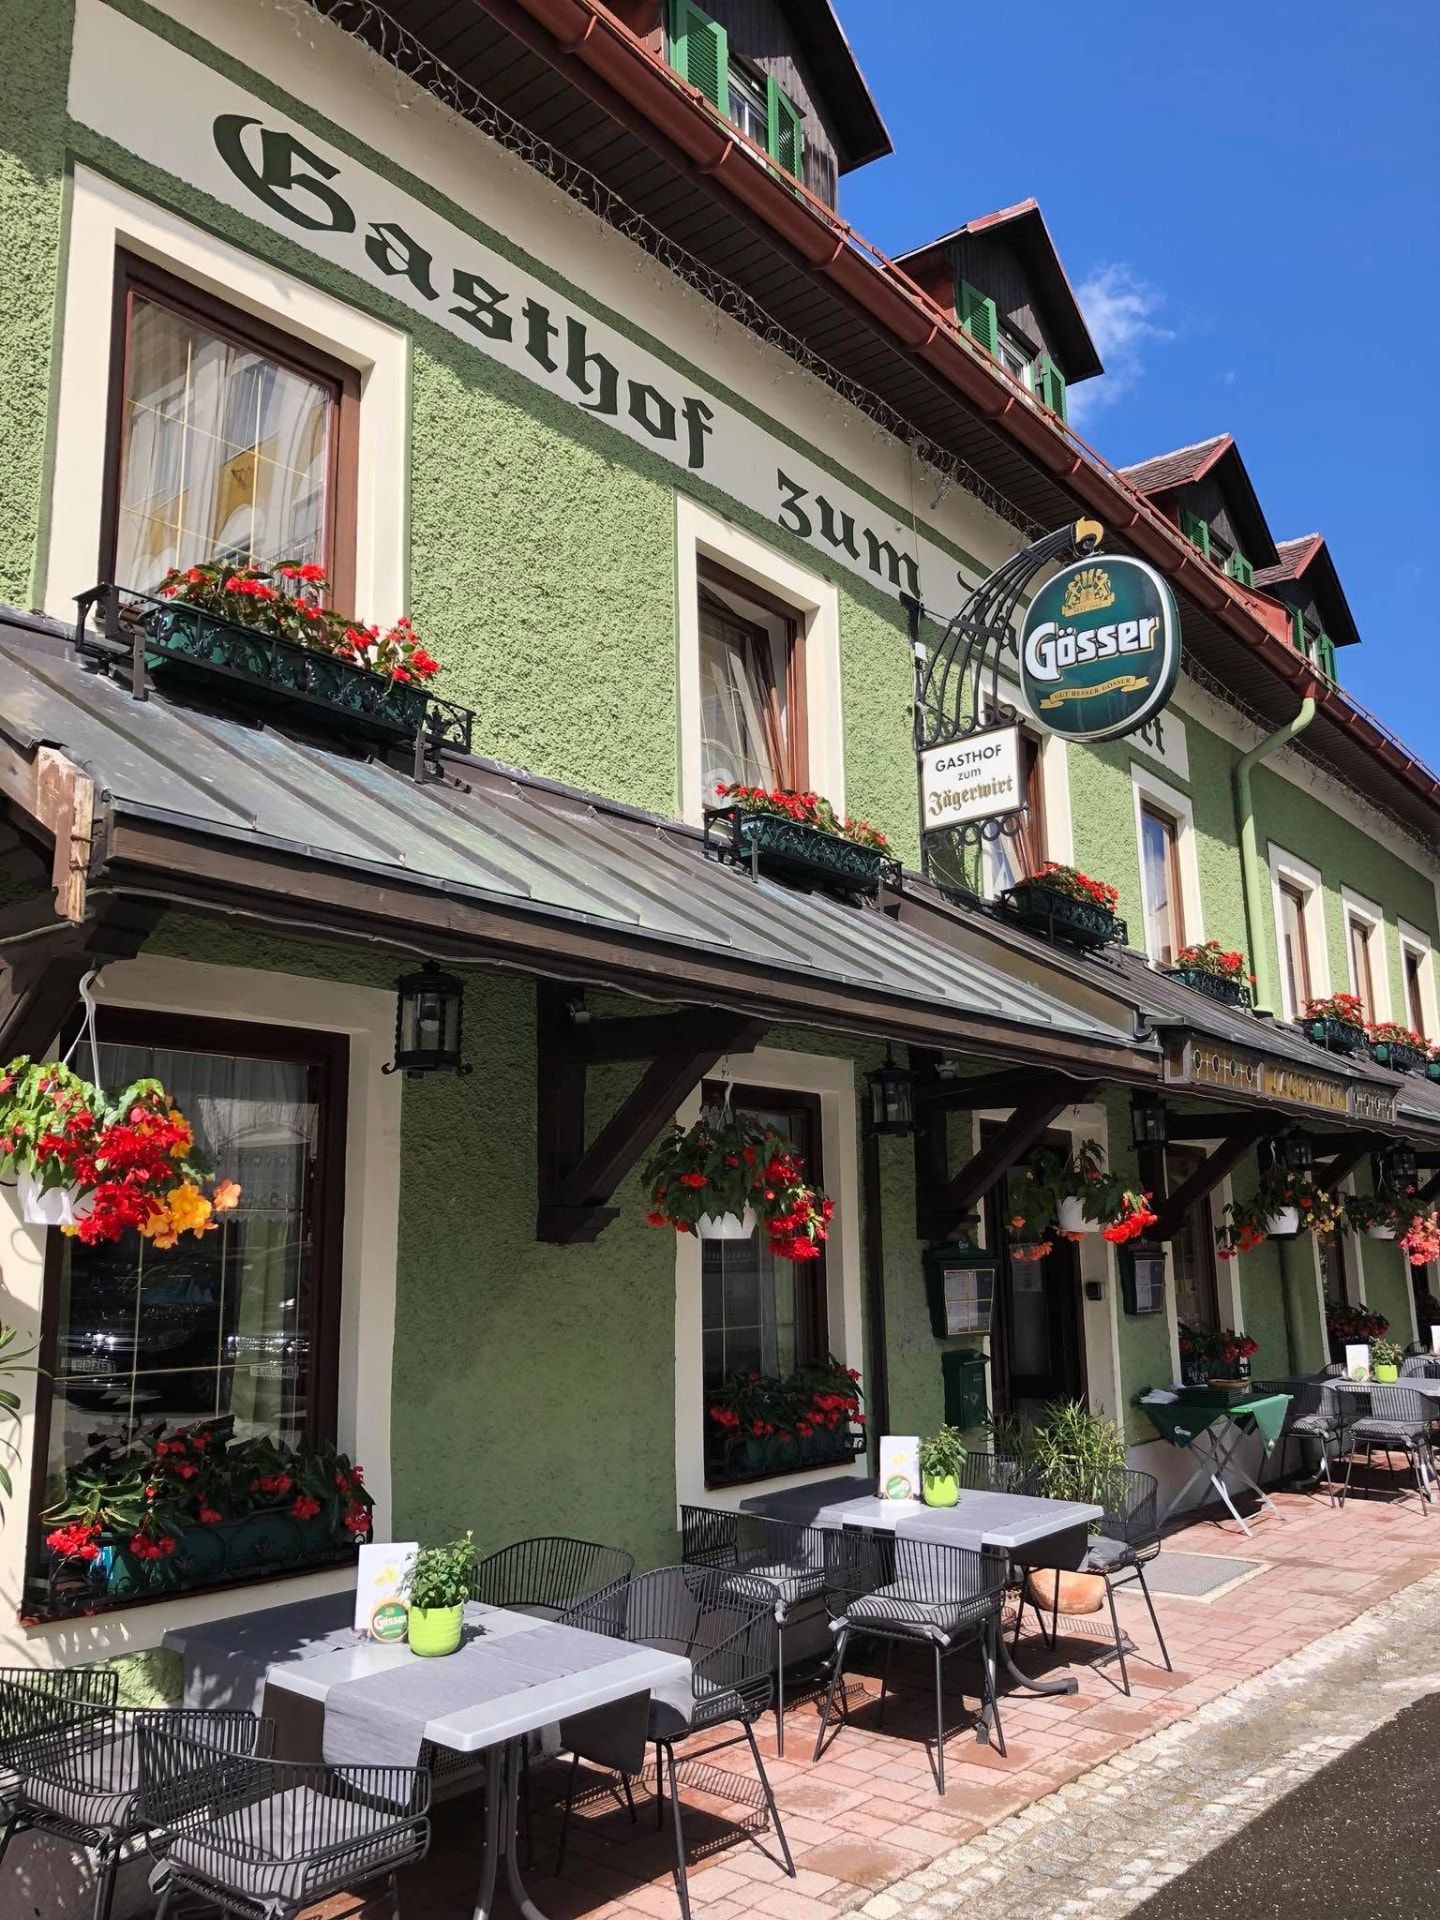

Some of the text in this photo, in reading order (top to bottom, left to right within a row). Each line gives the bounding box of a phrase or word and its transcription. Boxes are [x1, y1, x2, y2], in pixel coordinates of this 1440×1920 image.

[212, 113, 714, 469] Gasthof
[1025, 616, 1160, 681] Gösser
[1054, 691, 1068, 700] GUT
[1071, 687, 1099, 697] BESSER
[935, 744, 1002, 773] GASTHOF
[957, 768, 981, 781] zum
[928, 774, 1013, 817] Jägerwirt
